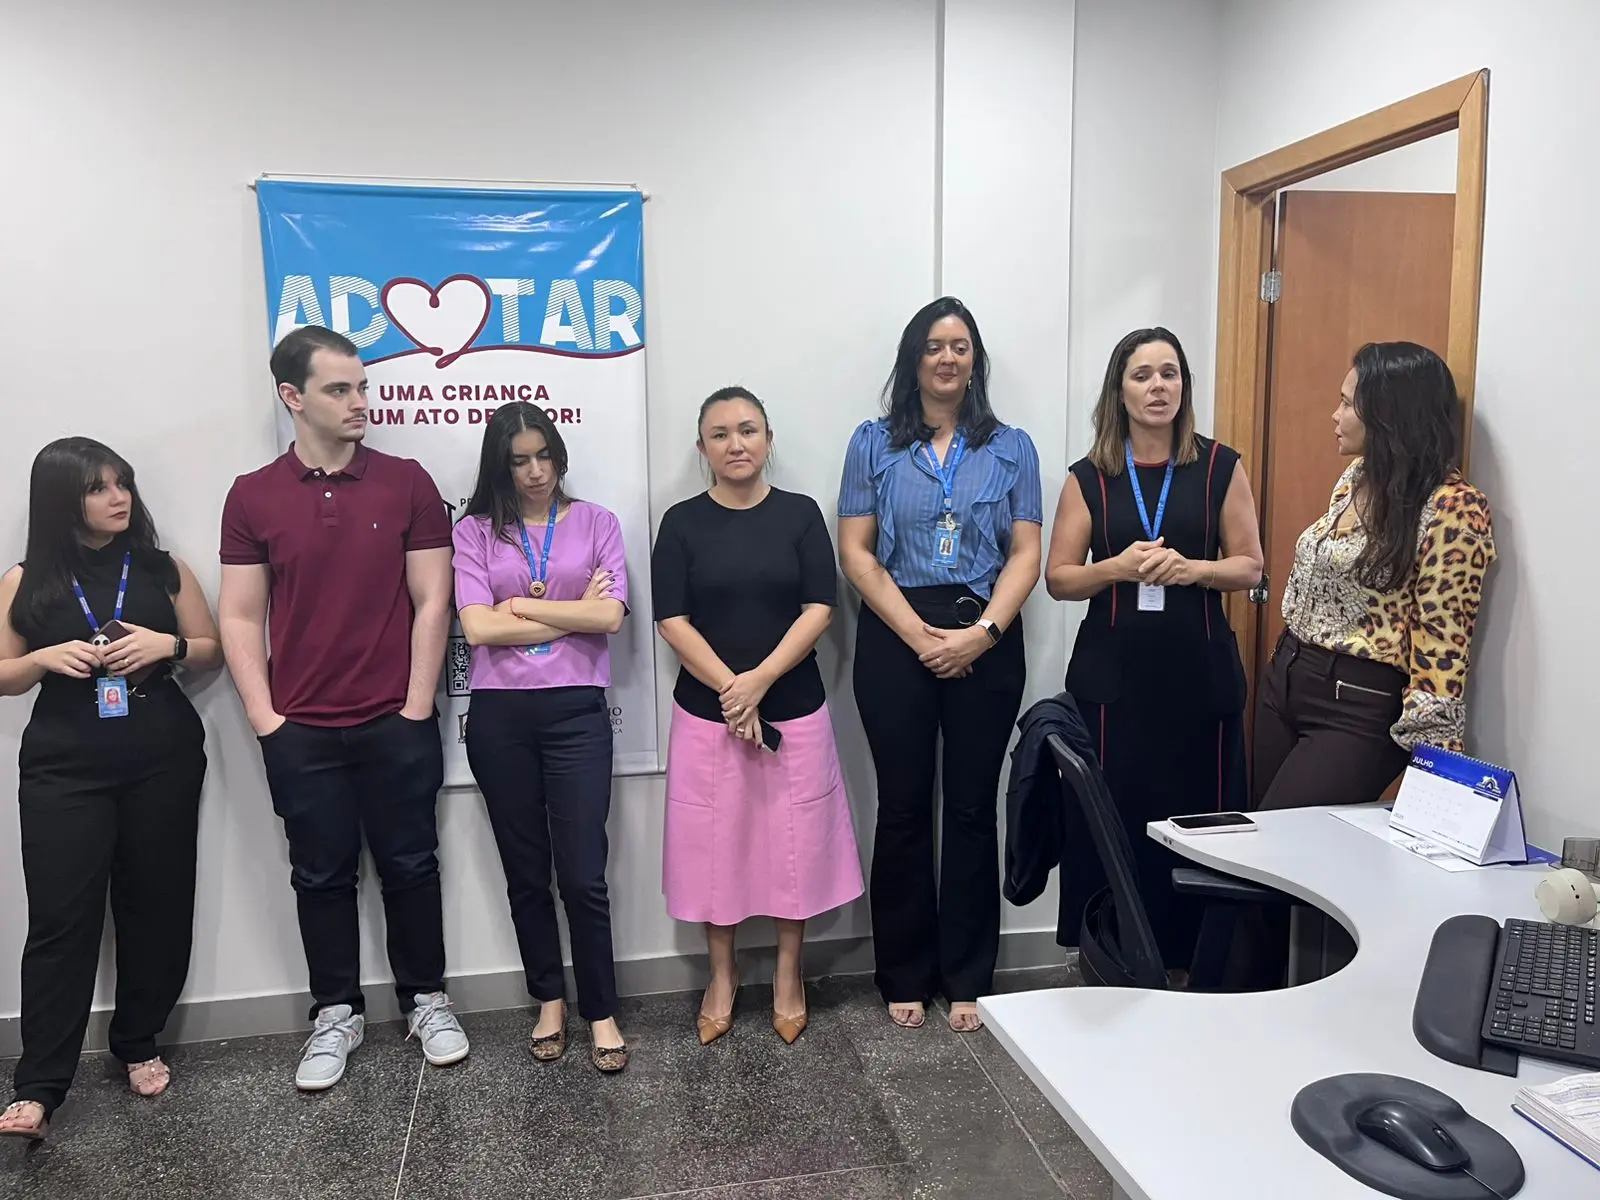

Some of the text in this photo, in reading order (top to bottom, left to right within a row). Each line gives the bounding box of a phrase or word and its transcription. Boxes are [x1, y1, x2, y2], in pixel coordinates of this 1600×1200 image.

[379, 384, 550, 403] UMA CRIANÇA
[369, 408, 405, 425] UM
[413, 408, 460, 425] ATO
[1412, 755, 1434, 769] JULHO
